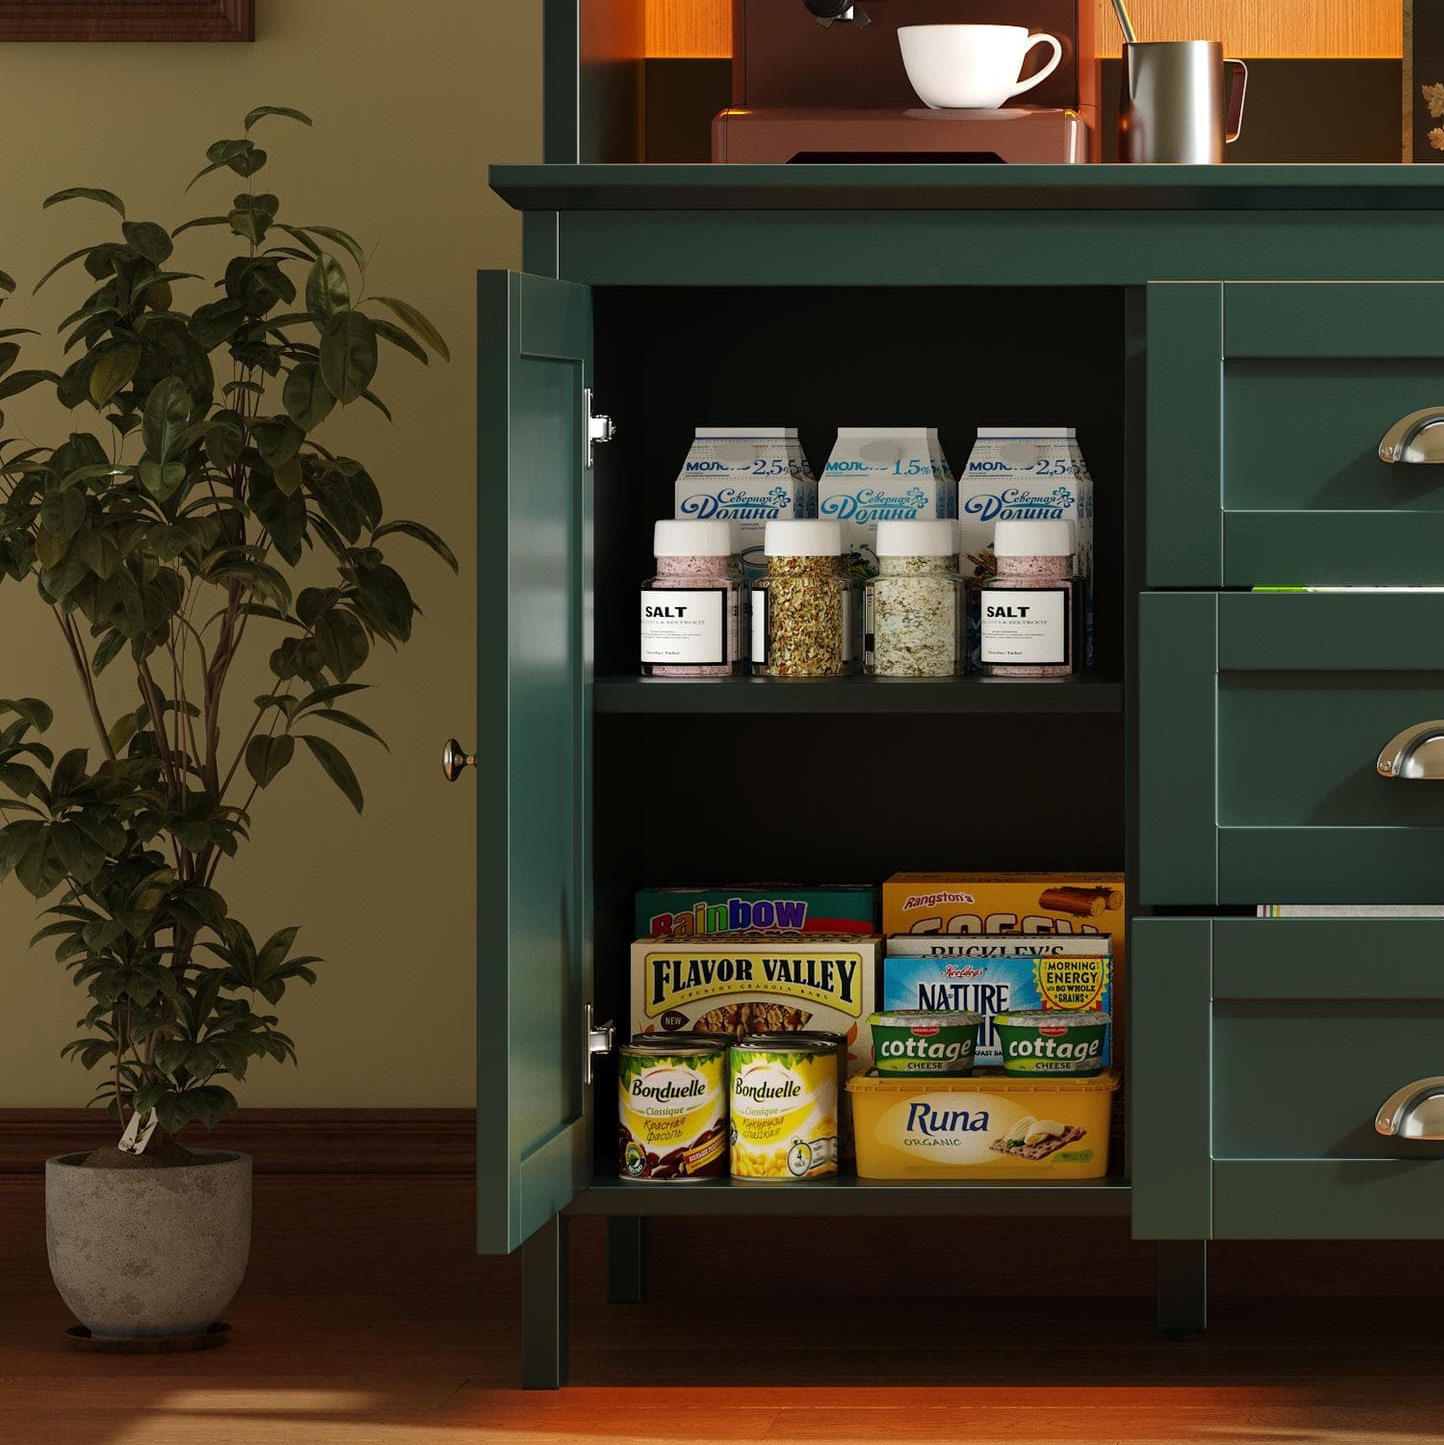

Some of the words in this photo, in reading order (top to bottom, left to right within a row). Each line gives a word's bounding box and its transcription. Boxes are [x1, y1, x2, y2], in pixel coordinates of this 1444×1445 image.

[718, 488, 773, 507] Северная
[856, 488, 911, 506] Северная
[1001, 488, 1057, 507] Северная
[680, 494, 779, 520] Долина
[820, 494, 918, 524] Долина
[964, 494, 1064, 522] Долина
[645, 606, 687, 618] SALT
[986, 606, 1030, 618] SALT
[904, 893, 975, 910] Rangston's
[651, 897, 808, 937] Rainbow
[1047, 961, 1096, 971] MORNING
[653, 958, 753, 1005] FLAVOR
[762, 959, 857, 1003] VALLEY
[1046, 971, 1098, 984] ENERGY
[1058, 993, 1085, 1003] GRAINS
[665, 1017, 682, 1025] NEW
[881, 1037, 972, 1063] cottage
[1008, 1037, 1099, 1063] cottage
[632, 1078, 706, 1103] Bonduelle
[735, 1078, 801, 1103] Bonduelle
[645, 1107, 684, 1117] Classique
[745, 1107, 779, 1117] Classique
[905, 1102, 990, 1136] Runa
[903, 1138, 962, 1148] ORGANIC
